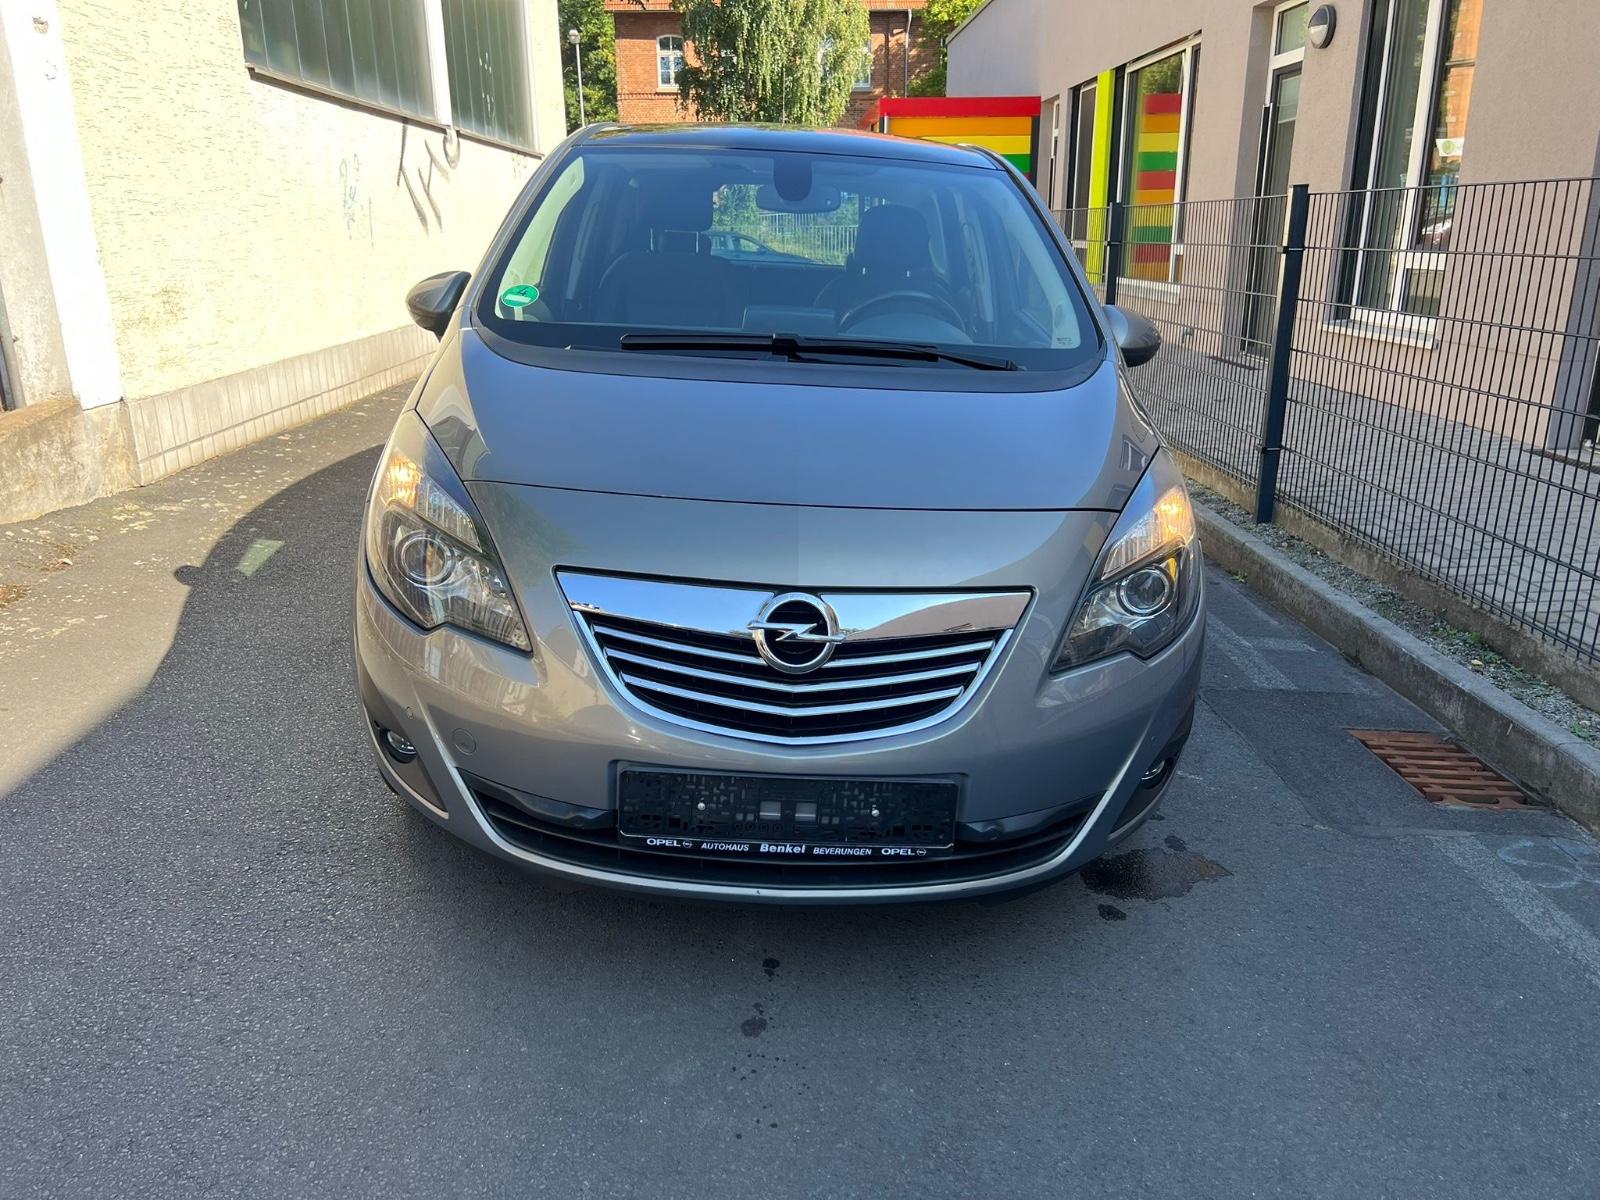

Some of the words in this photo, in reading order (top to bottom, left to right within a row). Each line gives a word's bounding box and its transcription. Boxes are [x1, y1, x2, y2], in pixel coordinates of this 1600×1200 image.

[646, 838, 681, 847] OPEL
[701, 842, 750, 851] AUTOHAUS
[760, 843, 806, 854] Benkel
[812, 846, 873, 856] BEVERUNGEN
[881, 847, 916, 856] OPEL
